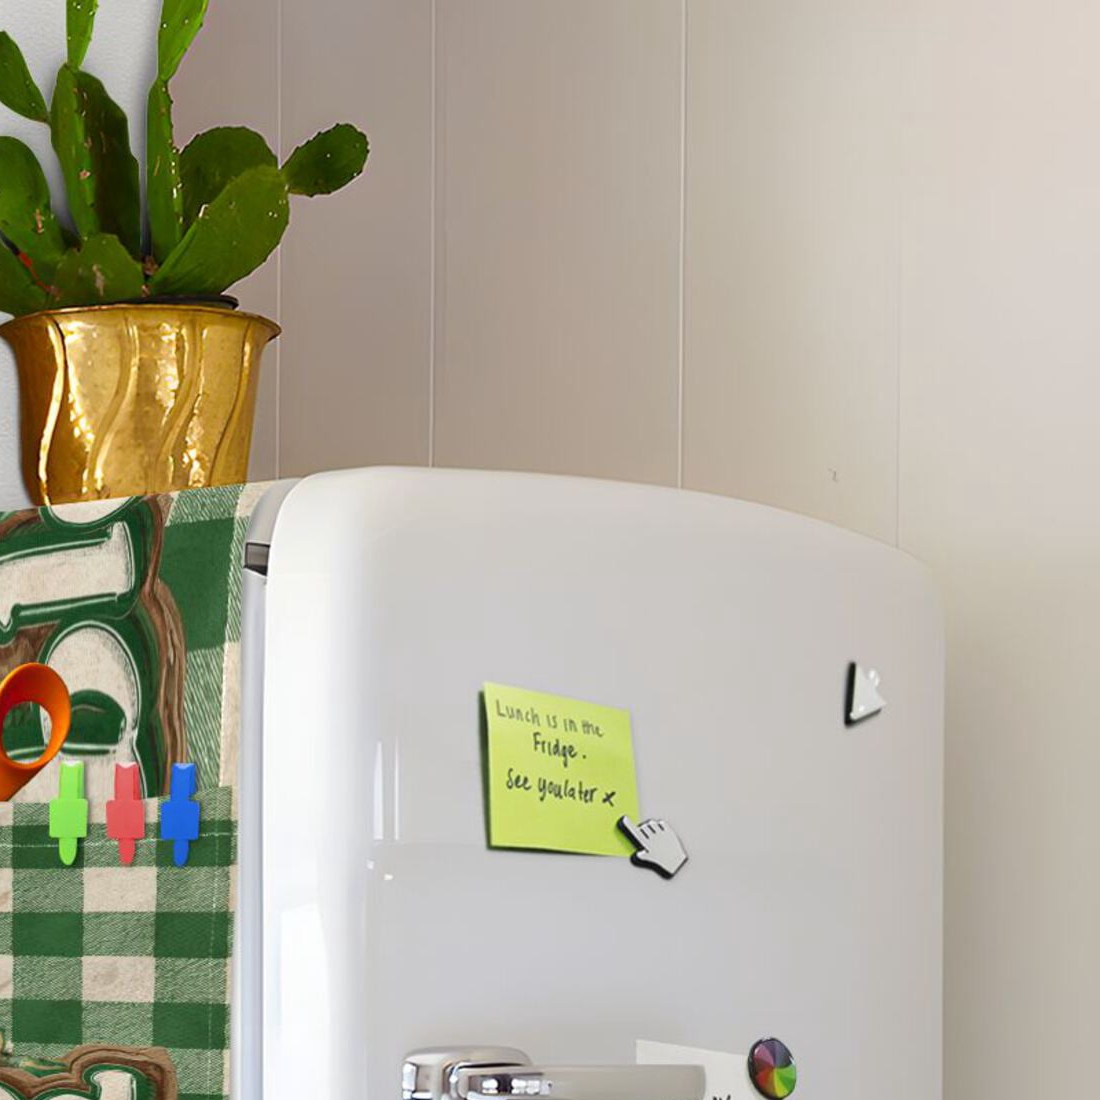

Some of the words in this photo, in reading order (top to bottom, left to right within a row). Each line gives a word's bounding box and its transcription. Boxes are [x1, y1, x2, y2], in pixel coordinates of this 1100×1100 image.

[495, 699, 541, 728] Lunch
[563, 717, 578, 733] in
[582, 719, 604, 738] the
[506, 767, 532, 791] See
